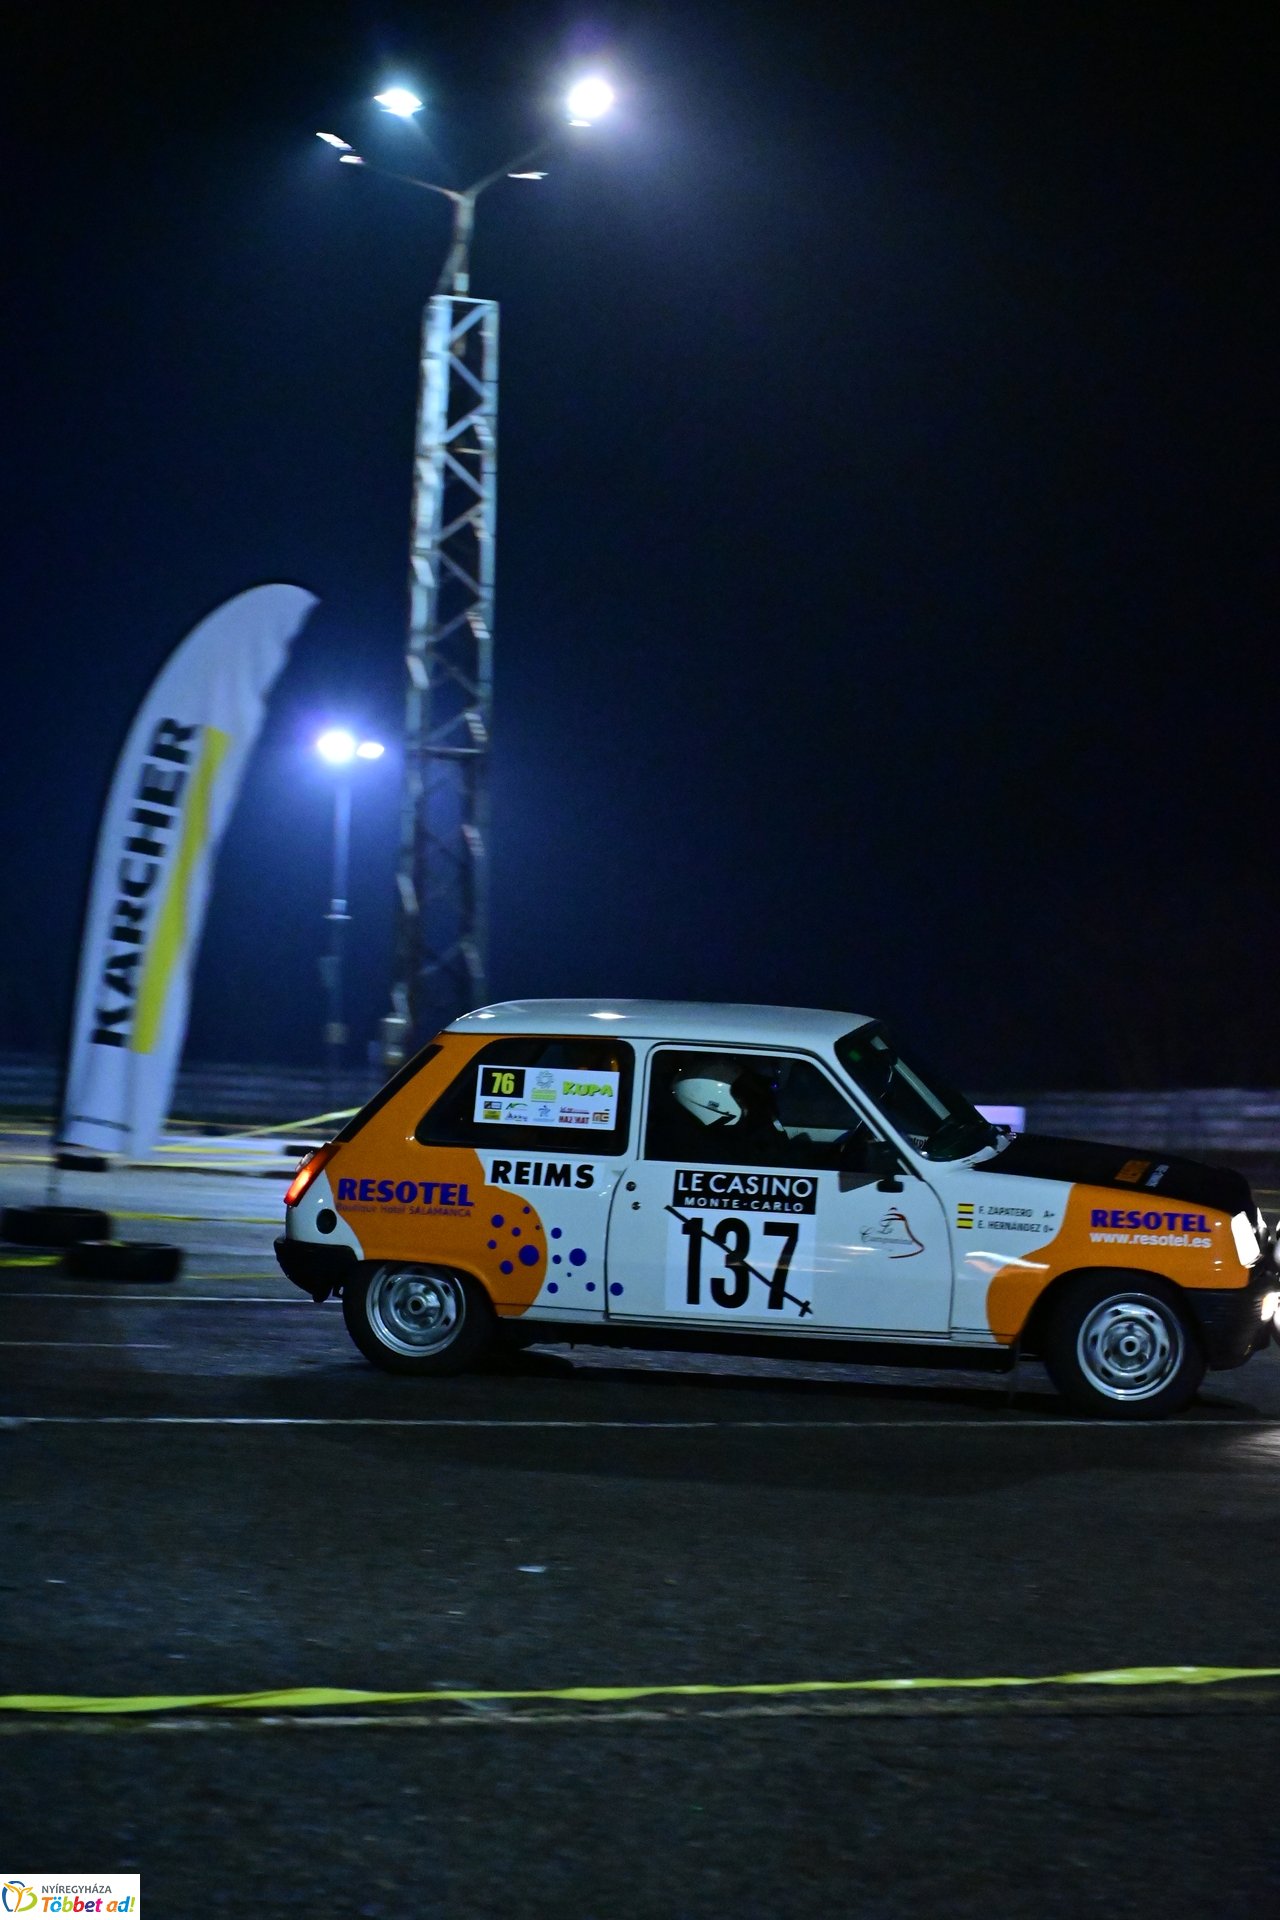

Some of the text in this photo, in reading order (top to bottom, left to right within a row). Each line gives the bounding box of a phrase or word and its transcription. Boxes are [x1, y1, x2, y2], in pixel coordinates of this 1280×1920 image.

[491, 1072, 515, 1095] 76
[562, 1080, 613, 1097] KUPA
[490, 1160, 595, 1189] REIMS
[677, 1172, 814, 1198] LE CASINO
[337, 1178, 475, 1207] RESOTEL
[409, 1206, 472, 1218] SALAMANCA
[988, 1206, 1033, 1217] ZAPATERO
[1091, 1209, 1211, 1233] RESOTEL
[1090, 1232, 1212, 1249] www.resotel.es
[681, 1217, 799, 1310] 137
